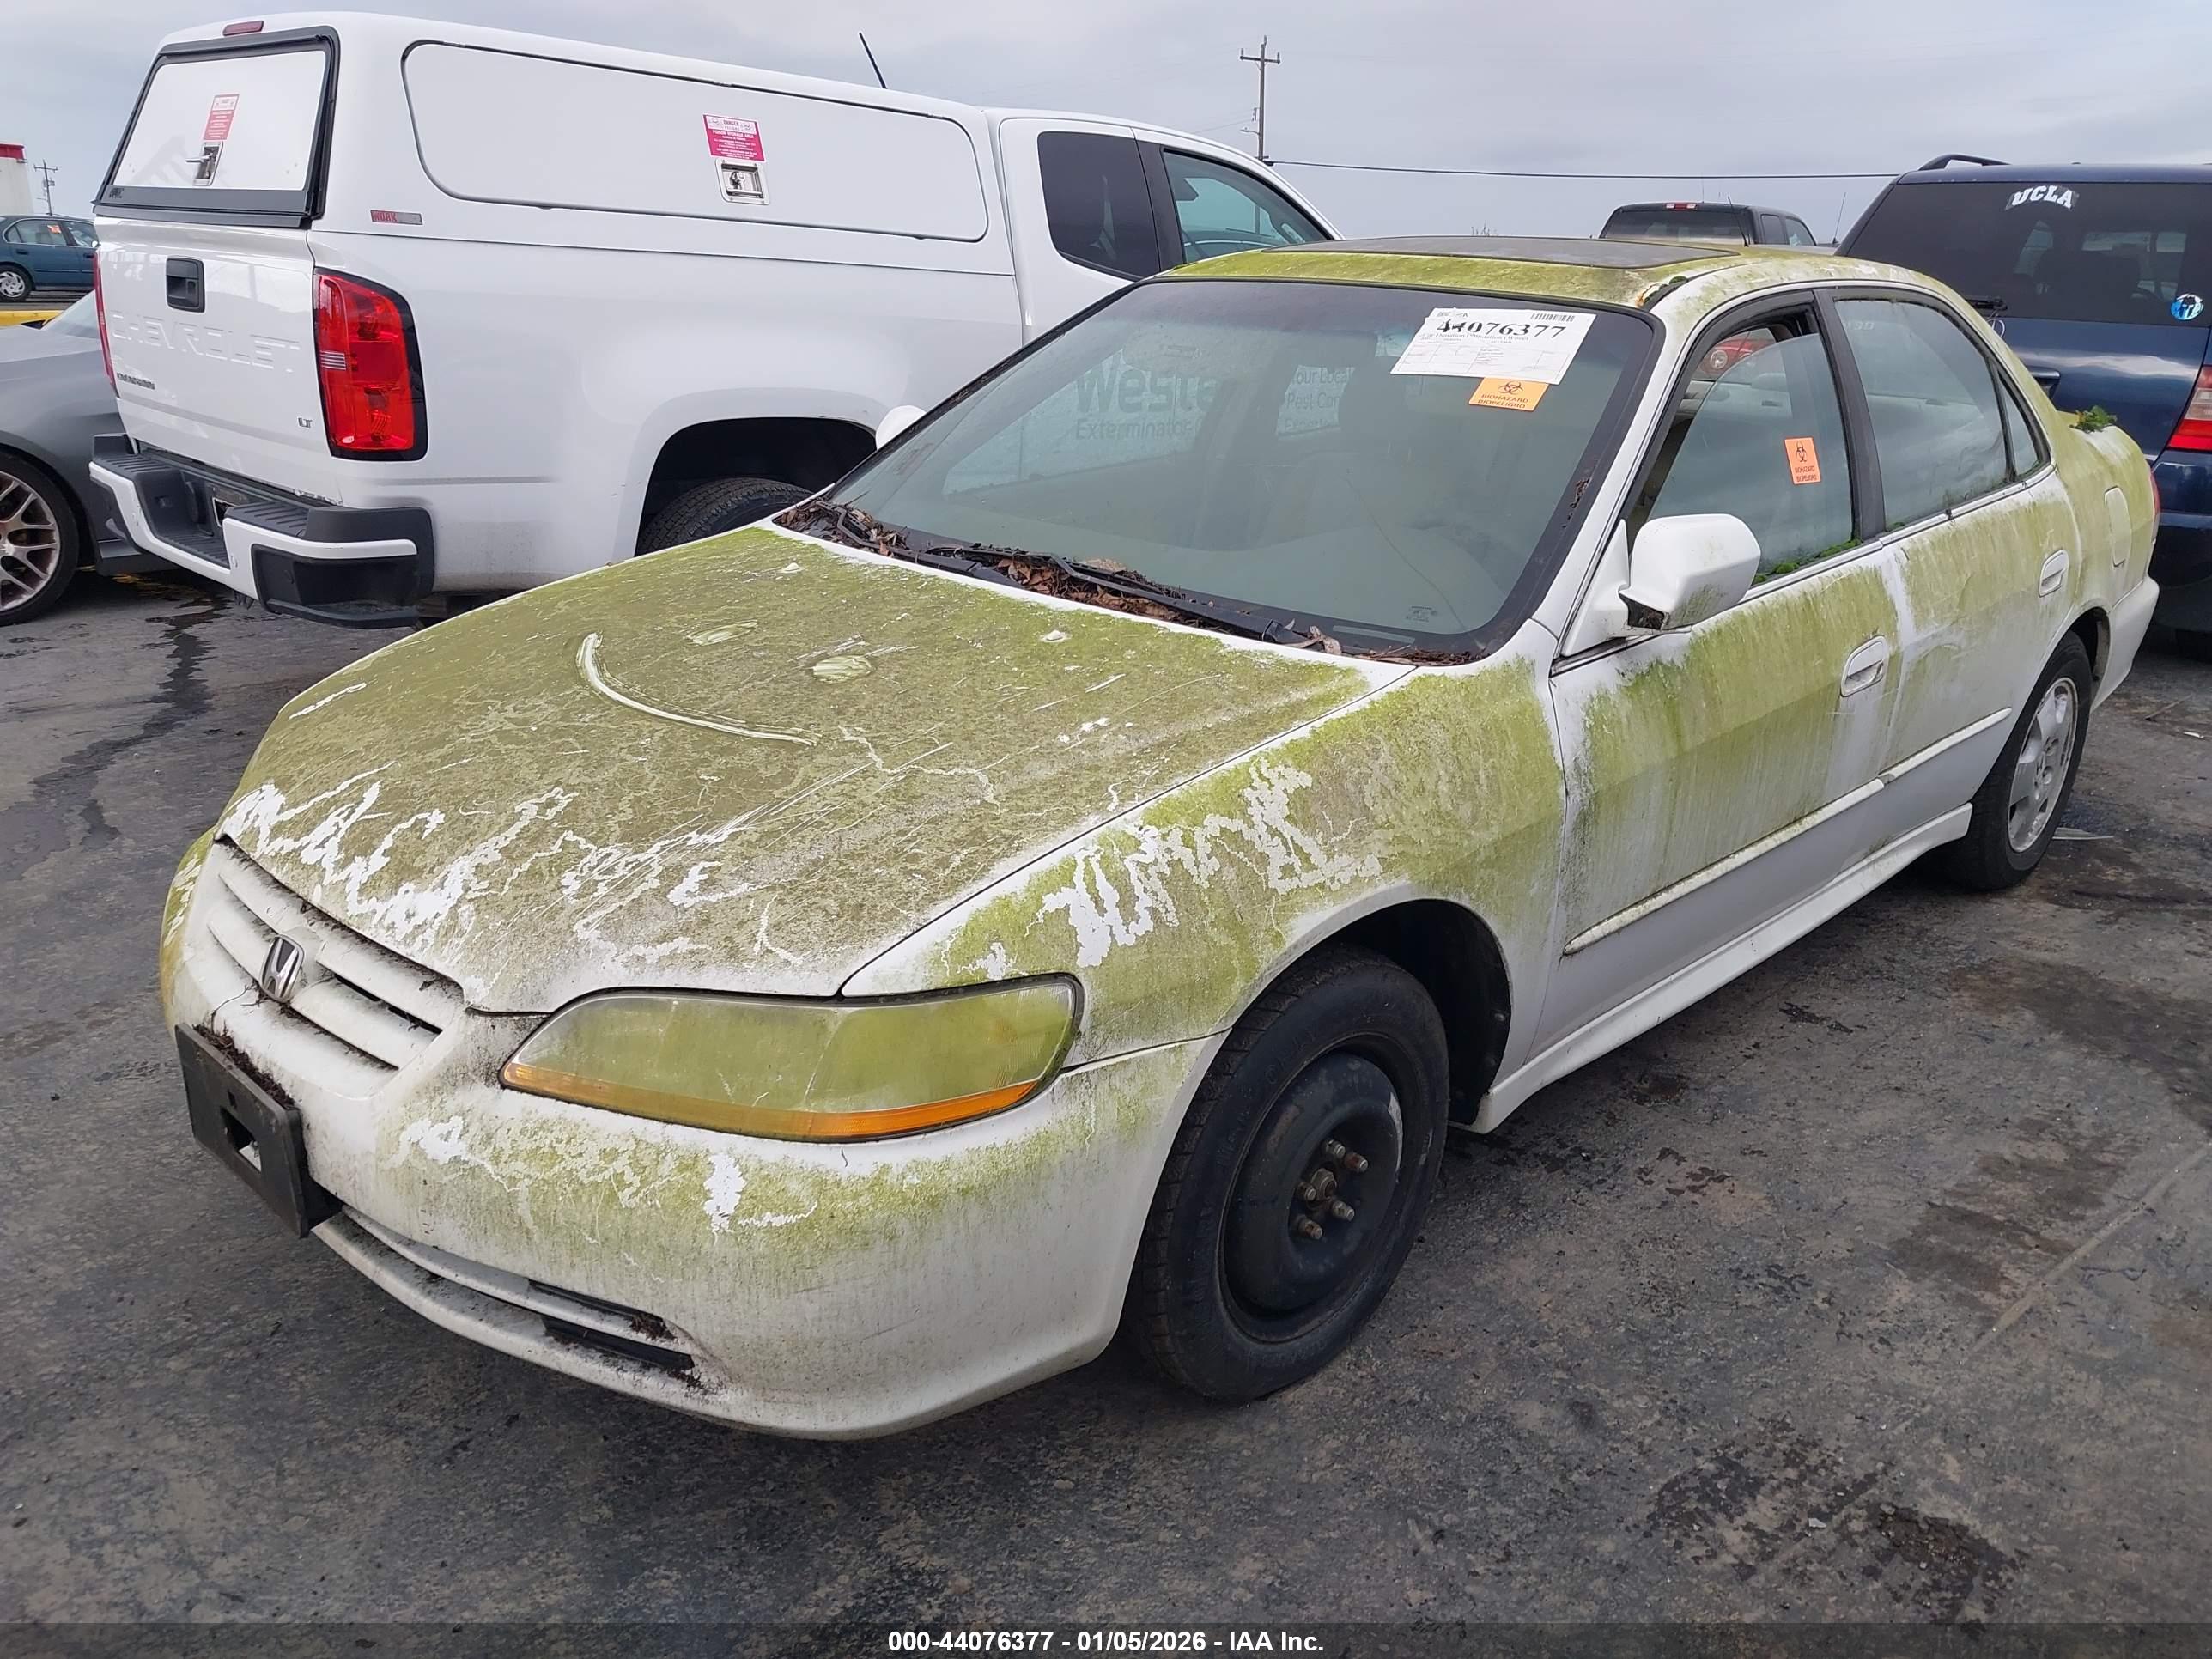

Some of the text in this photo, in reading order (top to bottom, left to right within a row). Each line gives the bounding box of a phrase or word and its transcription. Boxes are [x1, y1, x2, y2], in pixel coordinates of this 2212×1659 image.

[2011, 185, 2072, 209] UCLA
[110, 310, 301, 374] CHEVROLET
[1480, 393, 1529, 403] BIOHAZARD
[1477, 399, 1527, 409] BIOPELIGRO
[297, 417, 313, 428] LT
